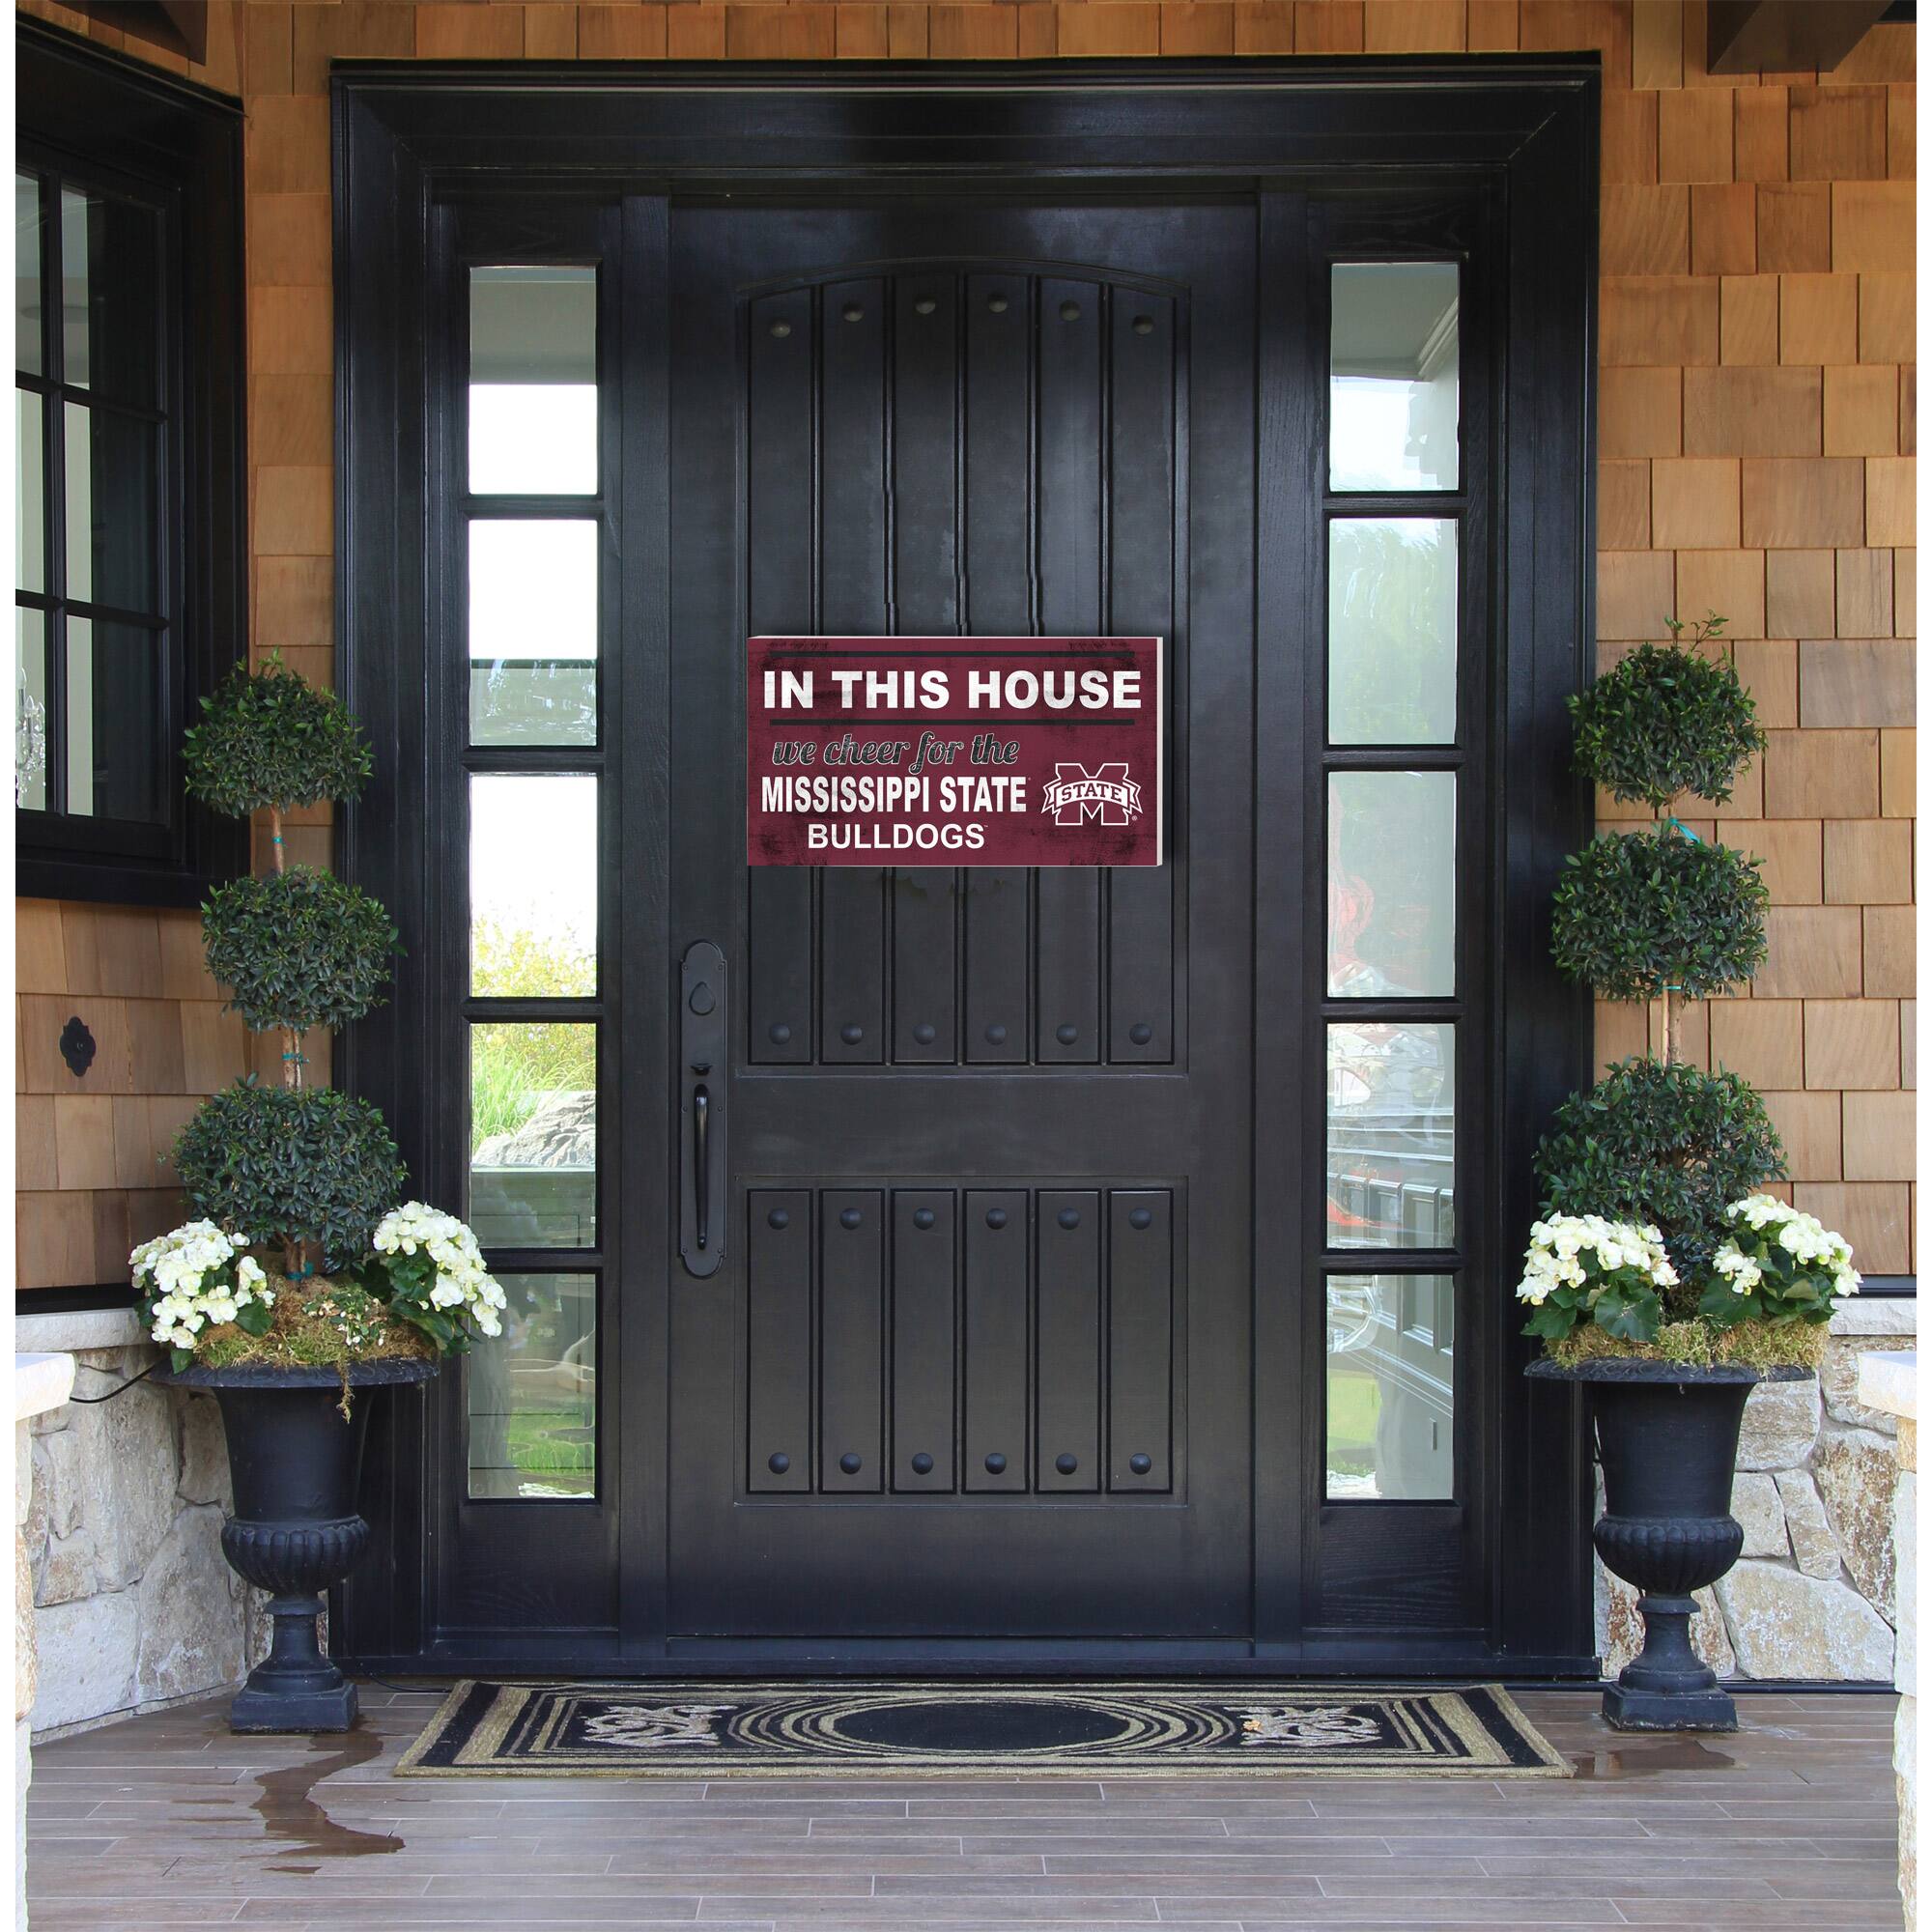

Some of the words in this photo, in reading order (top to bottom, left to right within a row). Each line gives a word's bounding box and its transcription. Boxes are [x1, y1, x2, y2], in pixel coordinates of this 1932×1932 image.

[764, 670, 813, 709] IN
[832, 669, 950, 710] THIS
[968, 669, 1142, 710] HOUSE
[772, 740, 817, 766] we
[823, 733, 911, 766] cheer
[908, 730, 964, 776] for
[970, 732, 1020, 765] the
[761, 775, 930, 813] MISSISSIPPI
[939, 775, 1028, 813] STATE
[1061, 782, 1122, 803] STATE
[807, 822, 985, 850] BULLDOGS
